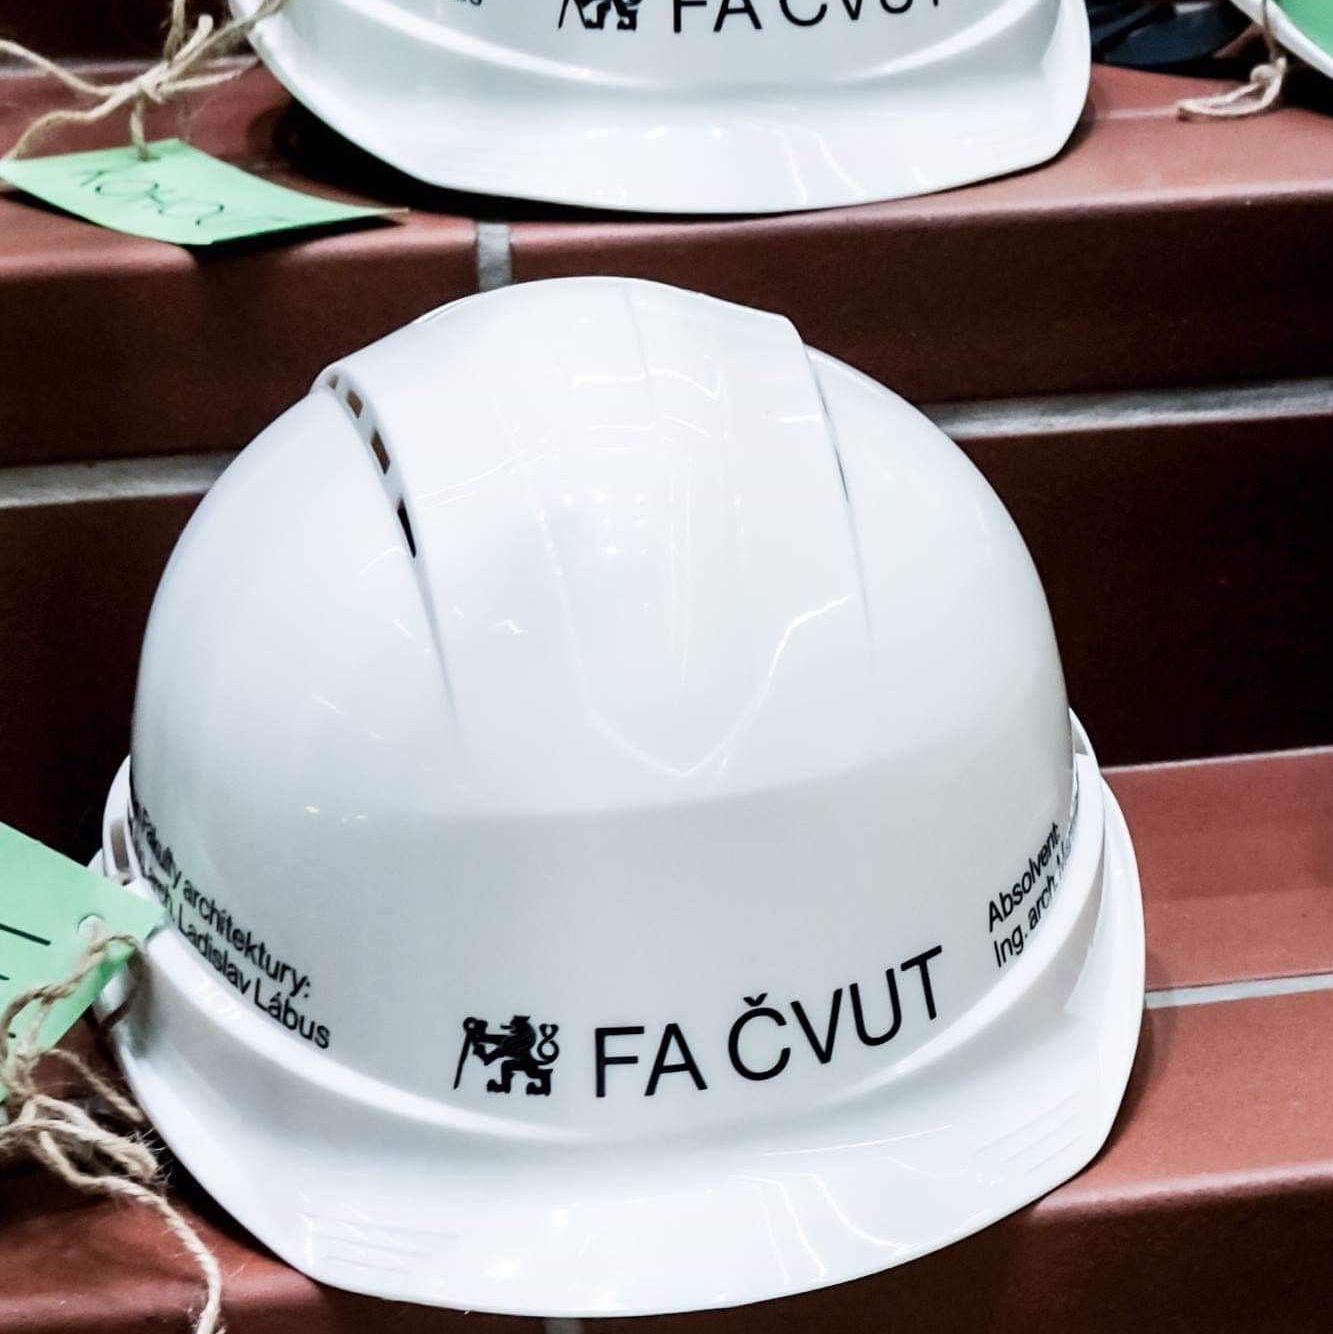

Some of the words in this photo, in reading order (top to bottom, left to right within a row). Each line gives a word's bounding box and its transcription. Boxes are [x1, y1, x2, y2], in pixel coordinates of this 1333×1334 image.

[177, 903, 252, 996] Ladislav
[254, 976, 332, 1050] Lábus
[182, 879, 312, 999] architektury:
[993, 924, 1029, 969] Ing.
[596, 1025, 710, 1099] FA
[726, 945, 945, 1083] ČVUT
